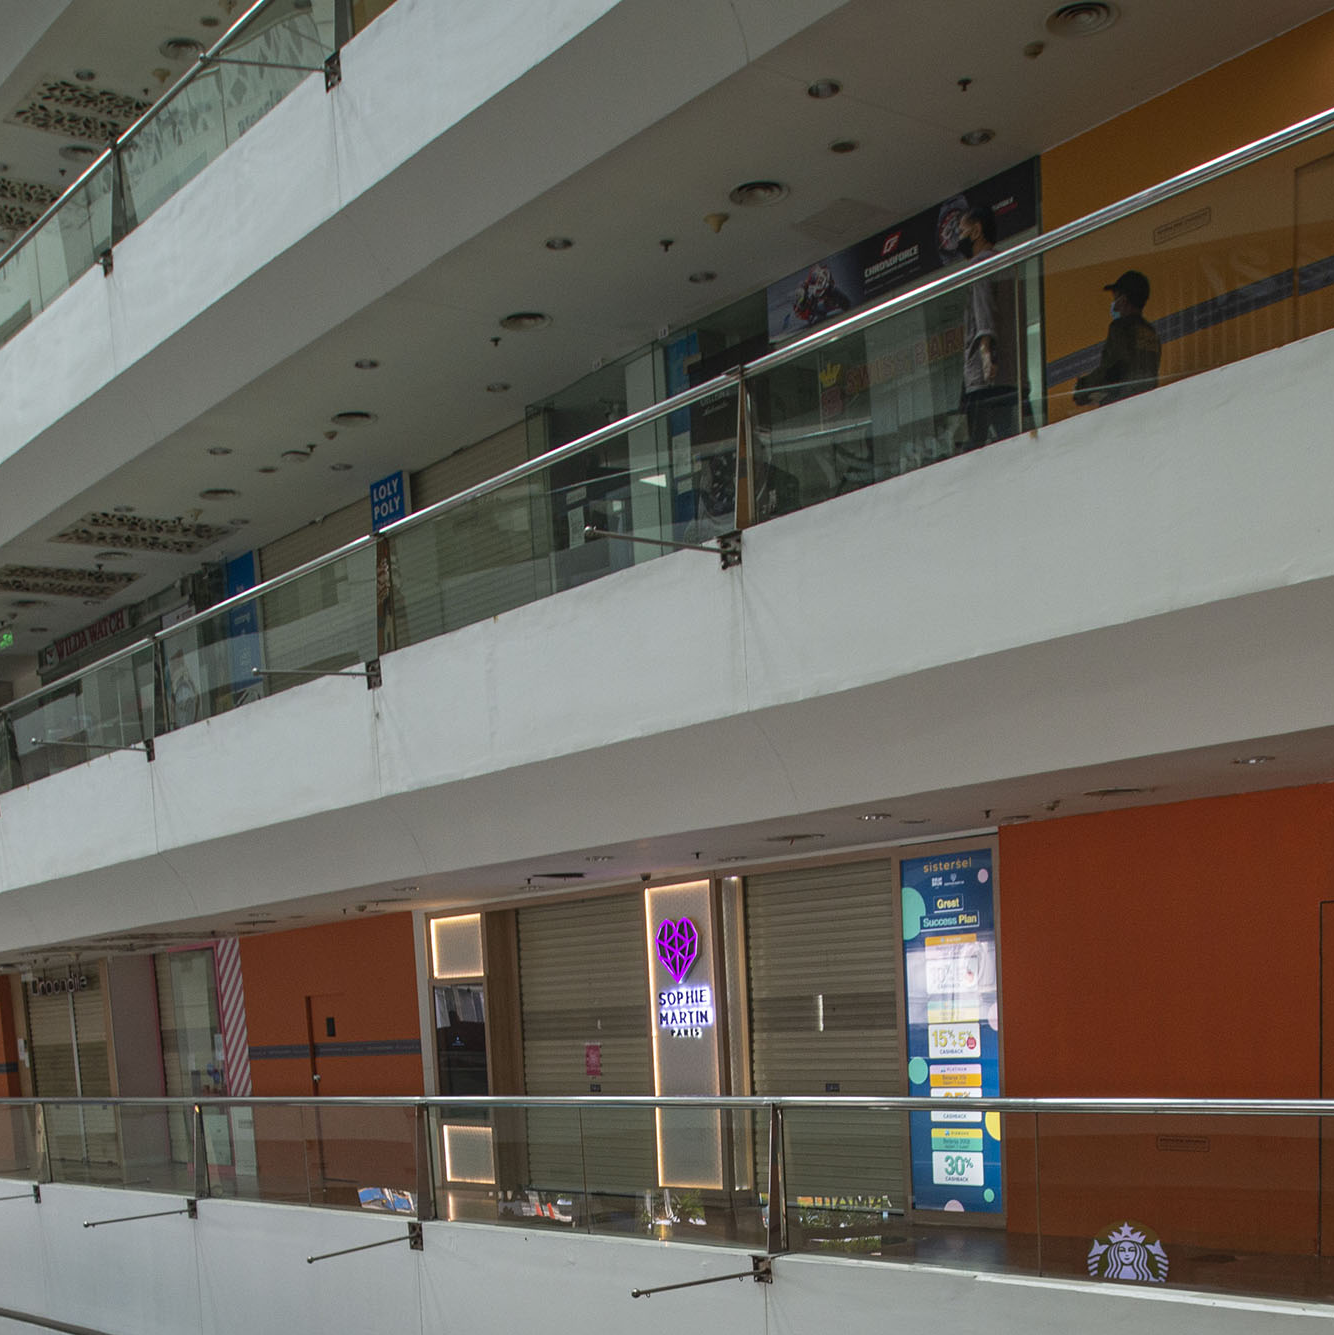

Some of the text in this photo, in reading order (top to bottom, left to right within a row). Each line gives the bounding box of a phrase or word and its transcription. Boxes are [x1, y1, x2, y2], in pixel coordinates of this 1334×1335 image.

[373, 477, 399, 503] LOLY
[373, 495, 401, 520] POLY
[55, 609, 126, 660] WILDA WATCH
[936, 897, 960, 909] Great
[923, 913, 977, 928] Success Plan
[658, 989, 707, 1006] SOPHIE
[659, 1010, 708, 1025] MARTIN
[670, 1028, 700, 1037] PARIS
[944, 1155, 974, 1176] 30%
